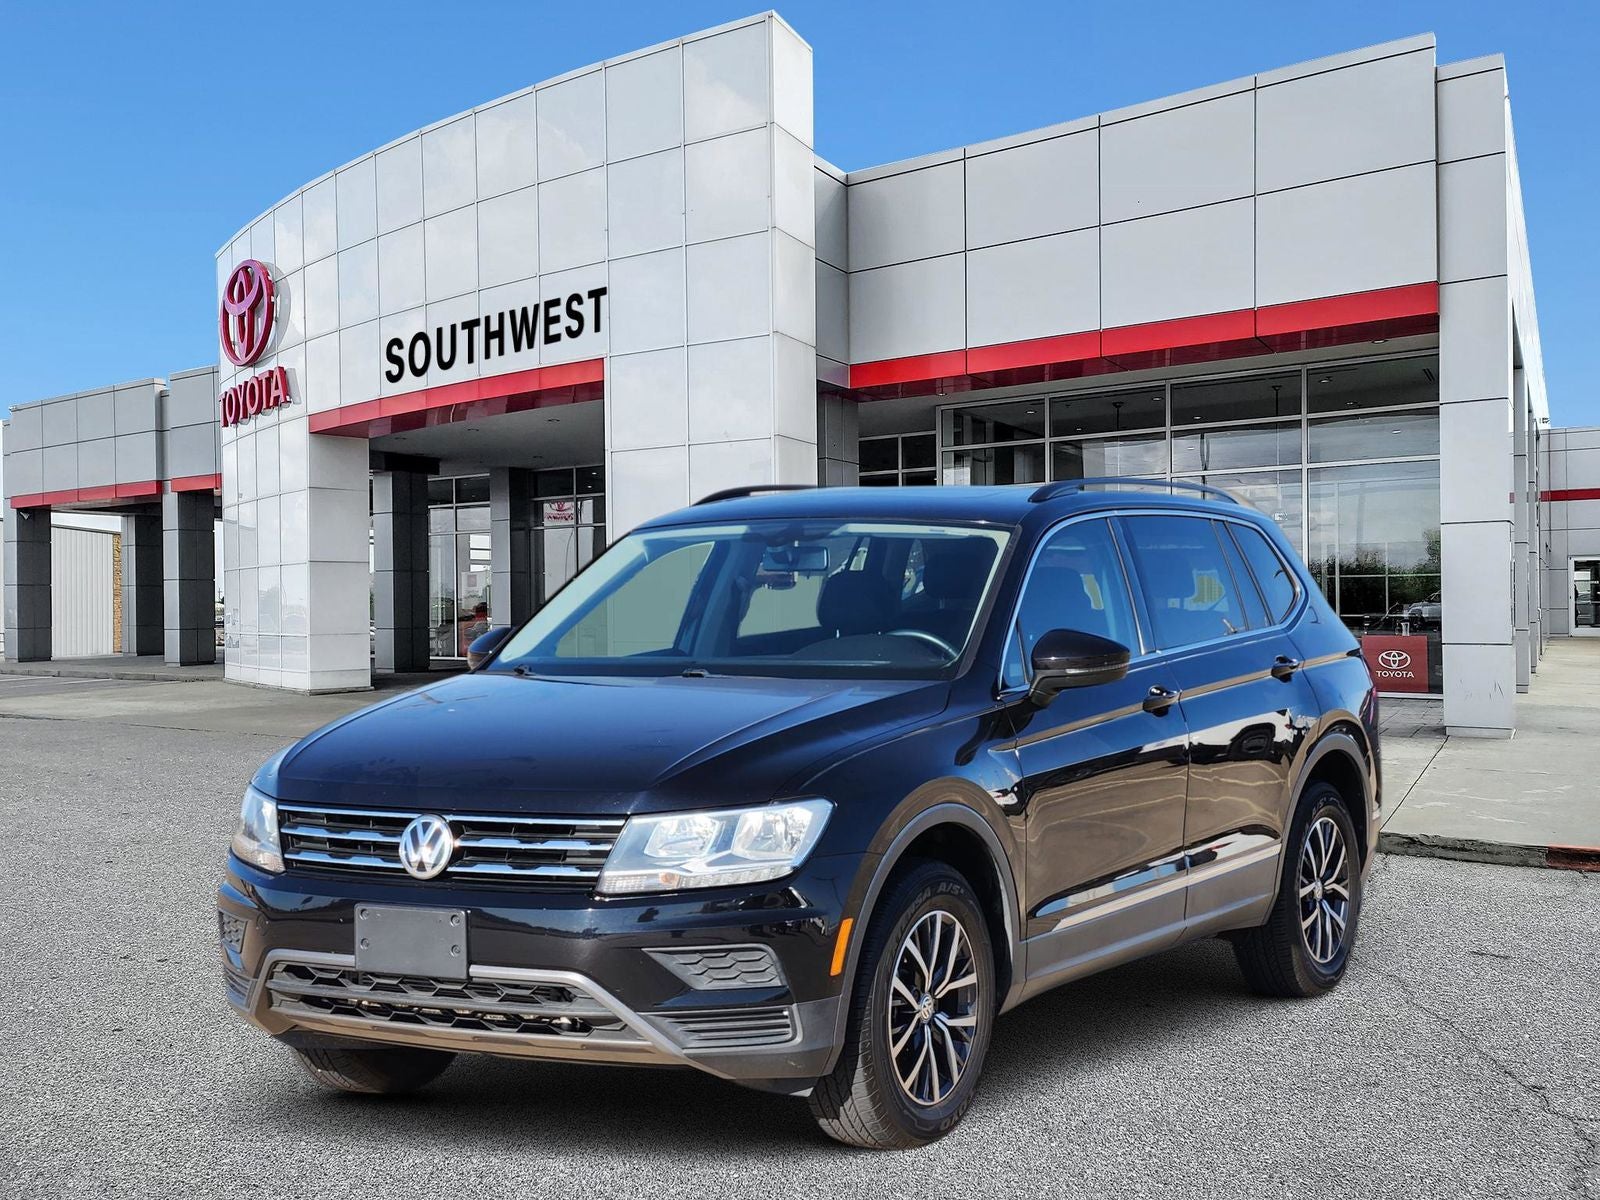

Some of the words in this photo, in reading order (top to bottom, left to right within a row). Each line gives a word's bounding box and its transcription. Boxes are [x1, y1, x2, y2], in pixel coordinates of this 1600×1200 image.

[385, 286, 608, 384] SOUTHWEST
[218, 366, 291, 427] TOYOTA
[1376, 670, 1414, 678] TOYOTA
